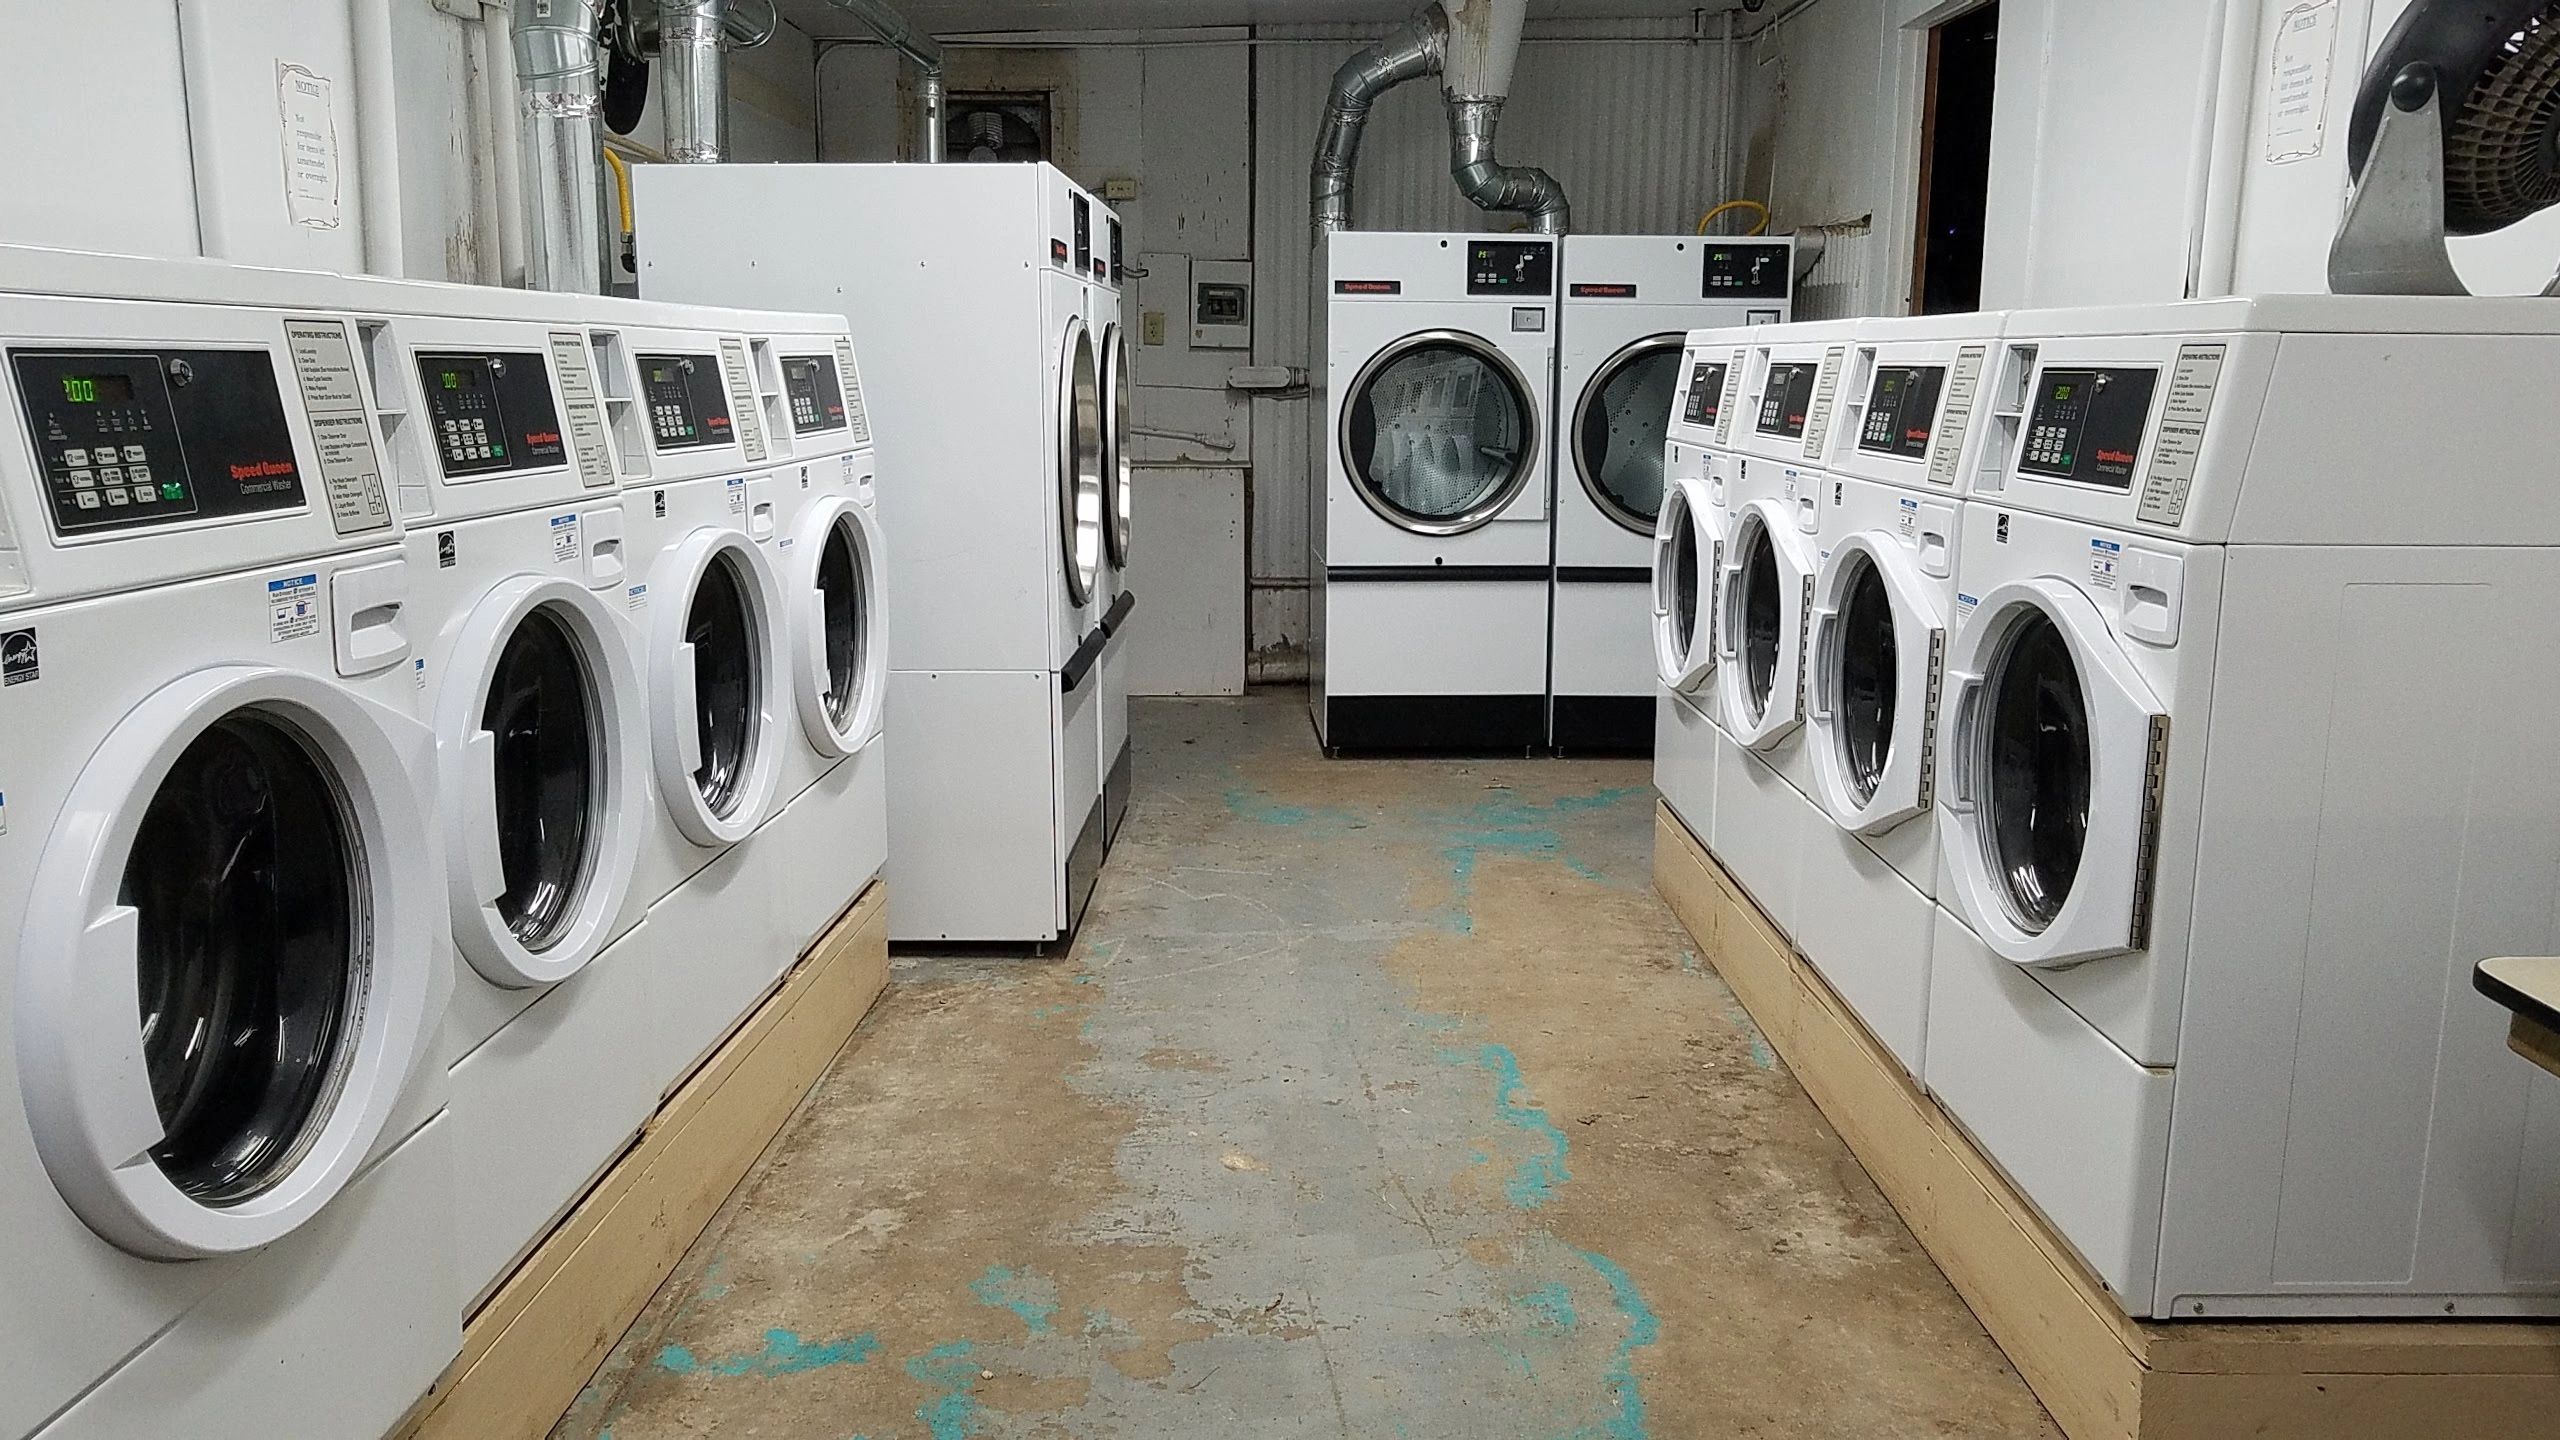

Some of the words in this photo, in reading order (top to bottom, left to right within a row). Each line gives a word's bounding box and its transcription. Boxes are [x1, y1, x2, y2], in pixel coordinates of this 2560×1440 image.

[295, 80, 319, 94] NOTICE
[230, 462, 262, 480] Speed
[262, 461, 293, 475] Queen
